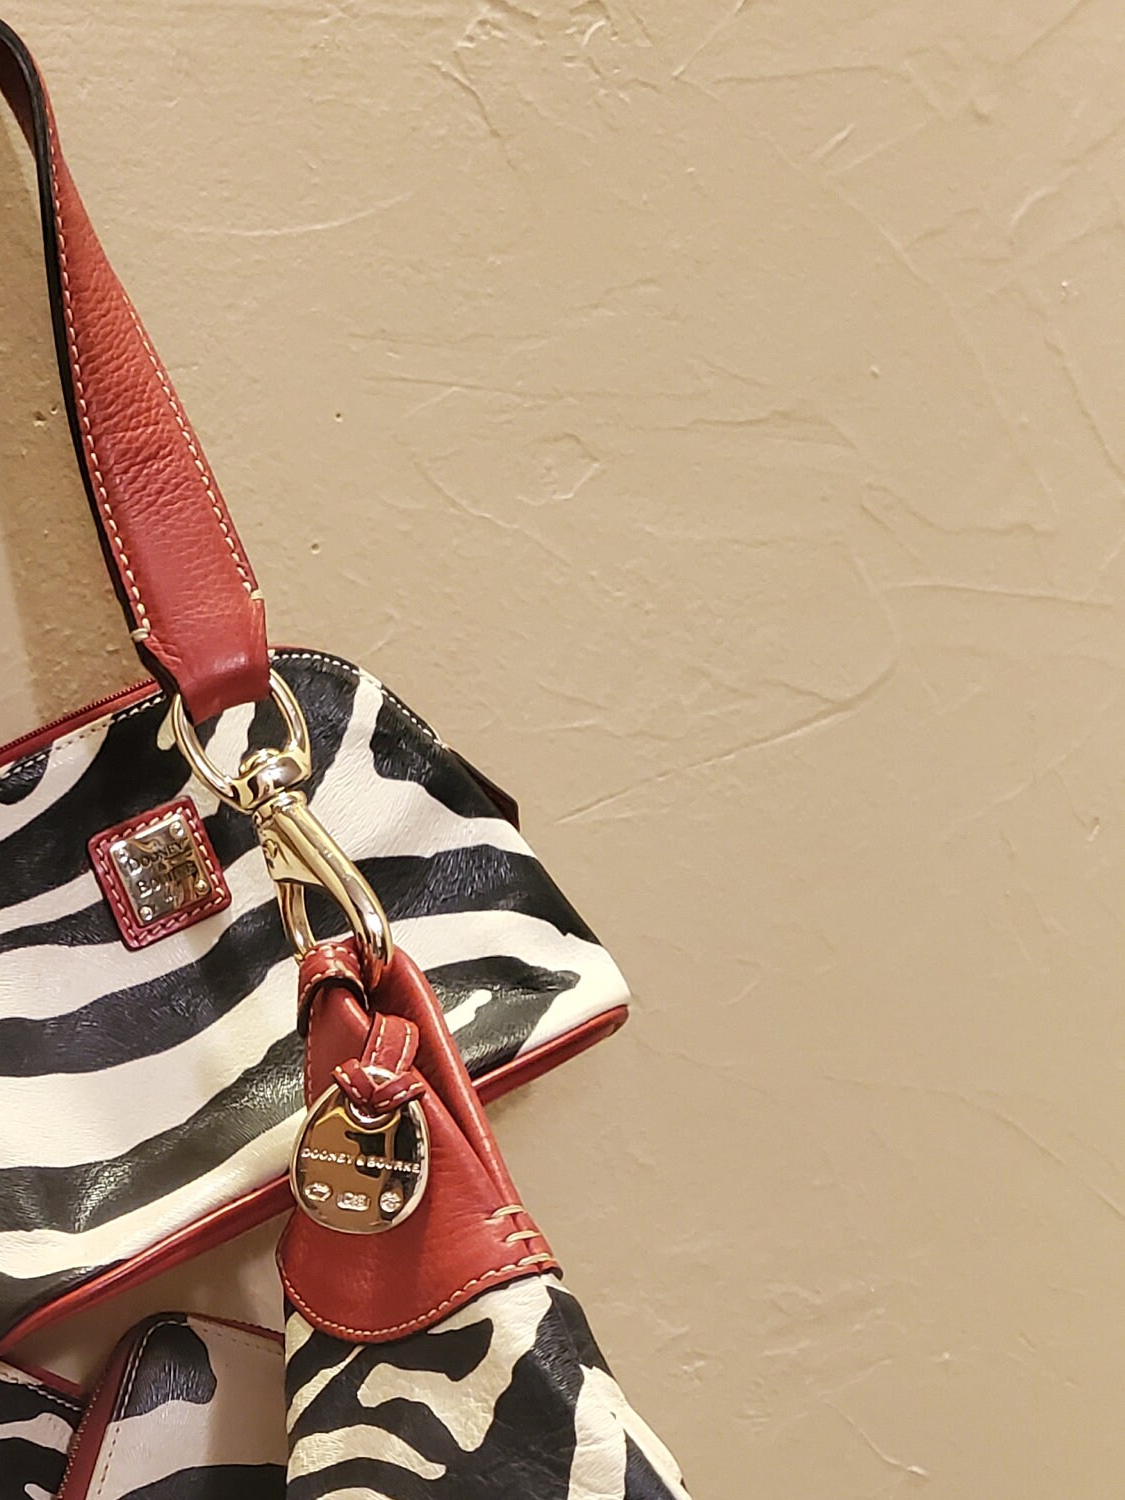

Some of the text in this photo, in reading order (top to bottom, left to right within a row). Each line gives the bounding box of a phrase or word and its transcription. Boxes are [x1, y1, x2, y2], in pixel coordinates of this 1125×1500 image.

[128, 841, 184, 876] DOONEY
[300, 1147, 353, 1165] DOONEY
[366, 1156, 421, 1174] BOURKE
